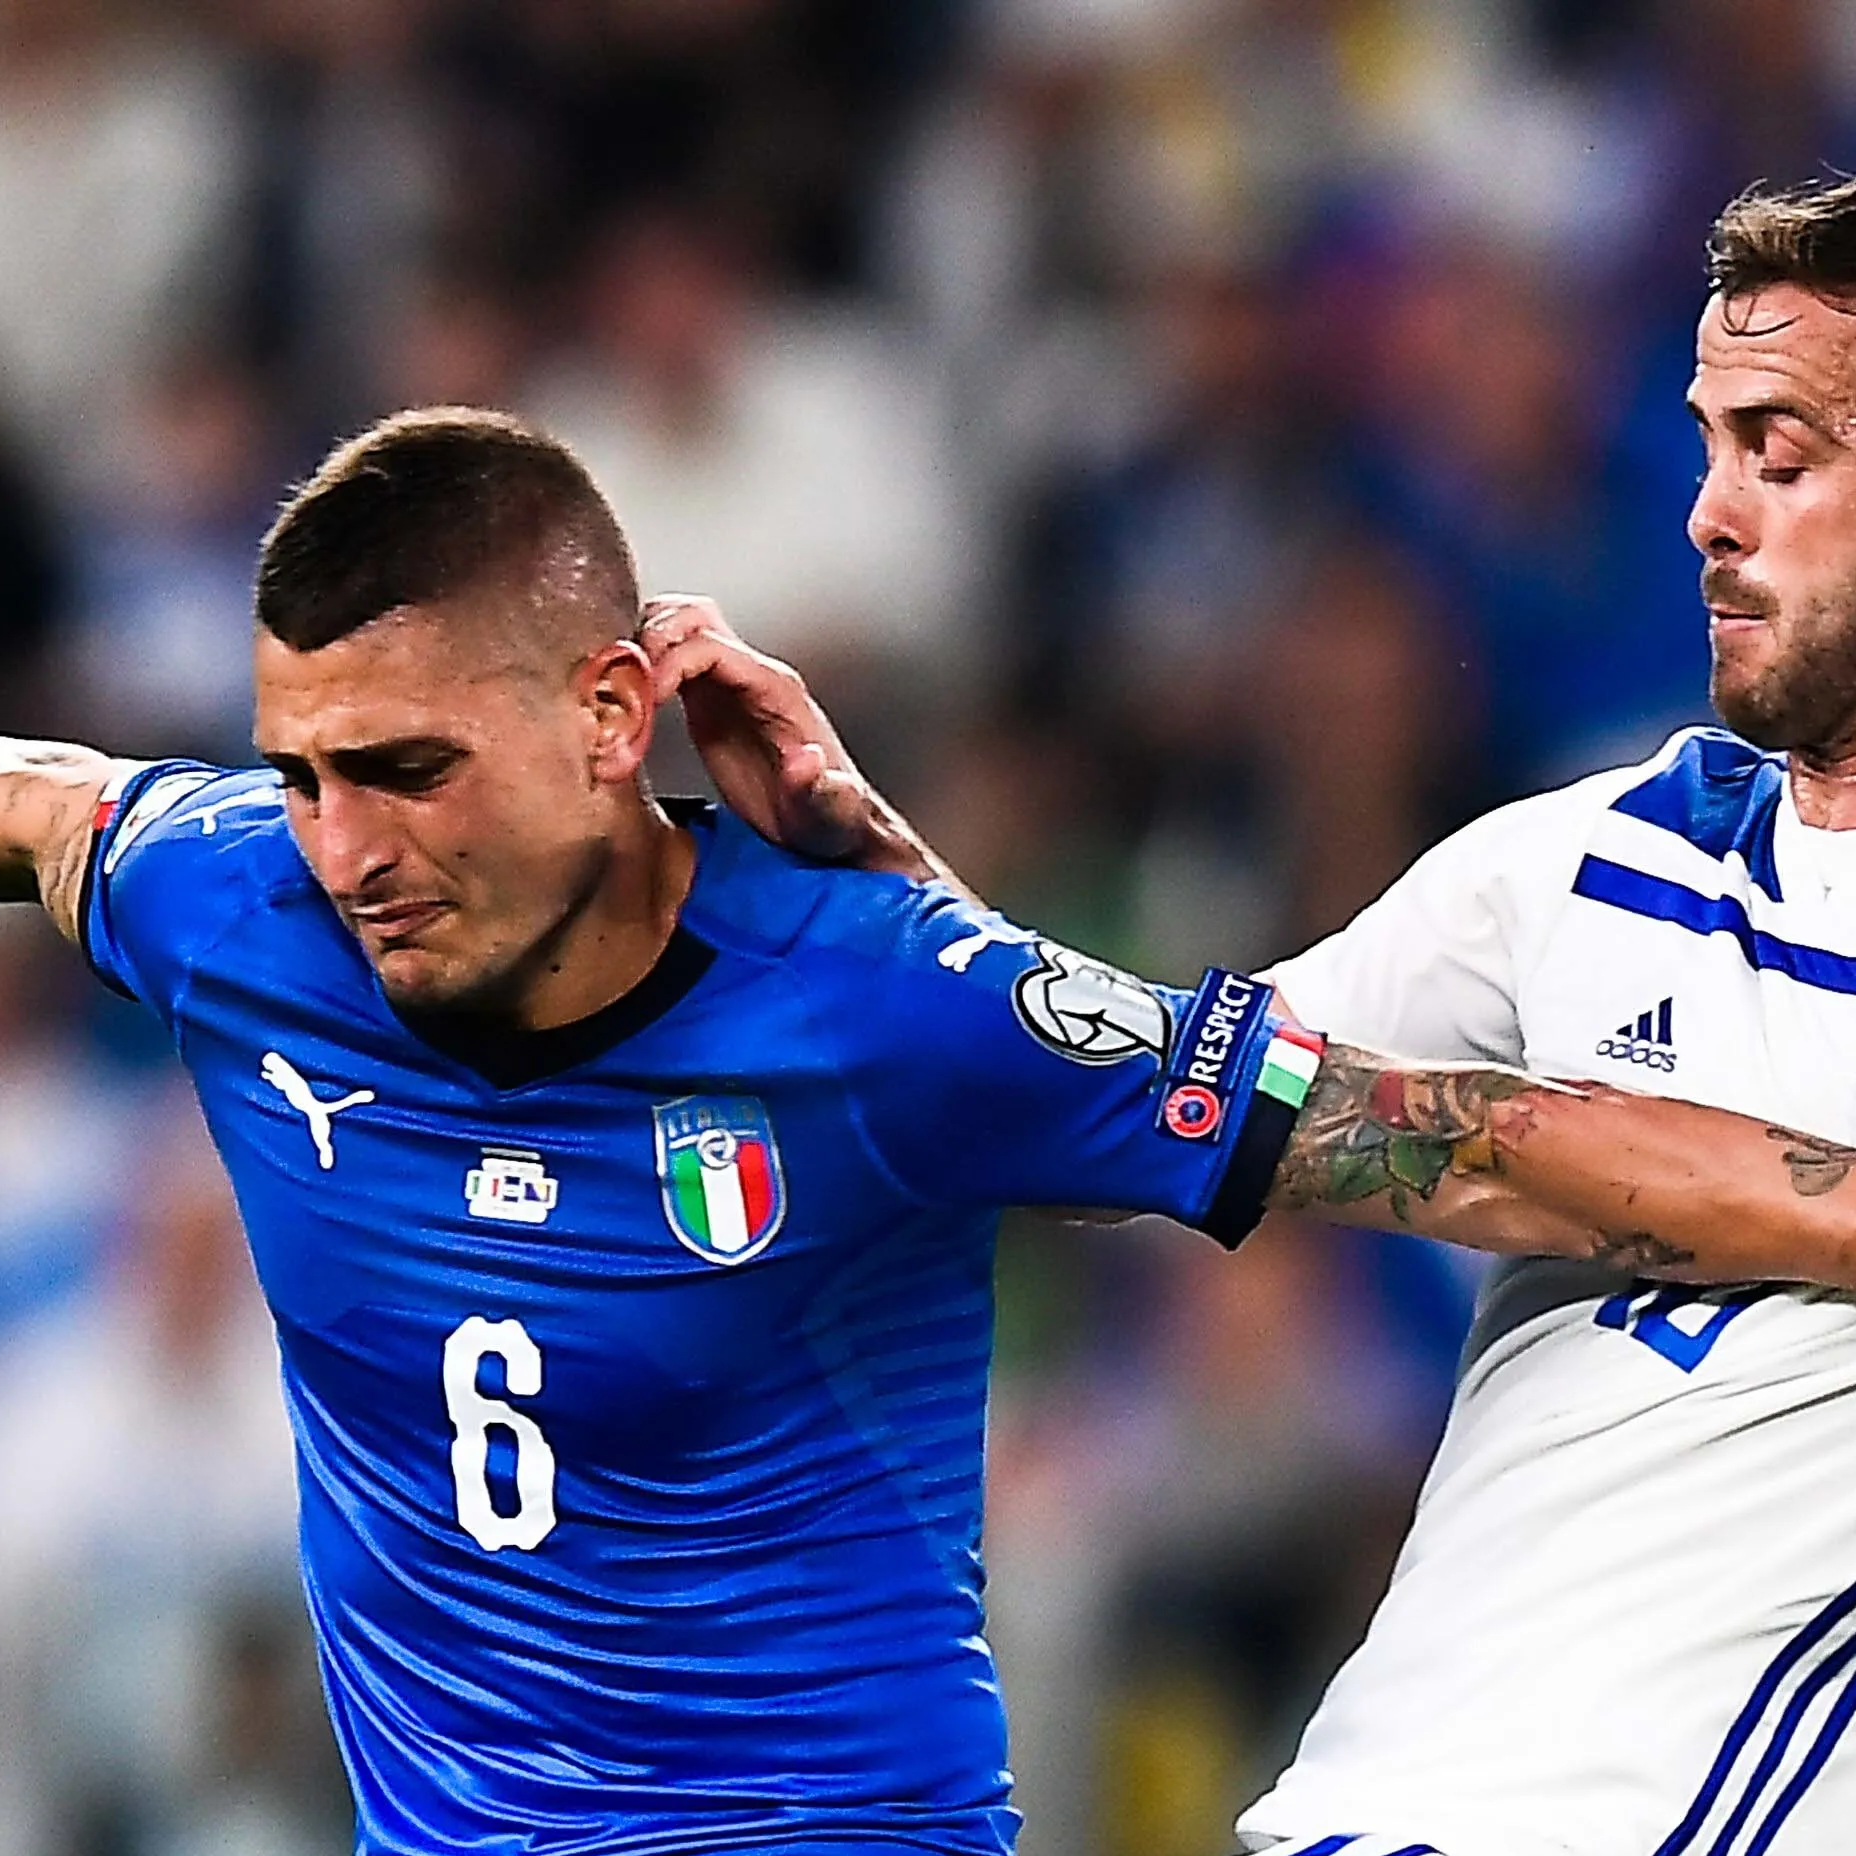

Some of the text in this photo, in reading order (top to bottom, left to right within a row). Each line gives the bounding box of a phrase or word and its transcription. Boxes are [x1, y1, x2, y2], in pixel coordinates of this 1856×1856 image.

[1188, 973, 1256, 1083] RESPECT
[1596, 1040, 1677, 1072] adidas
[442, 1315, 556, 1552] 6
